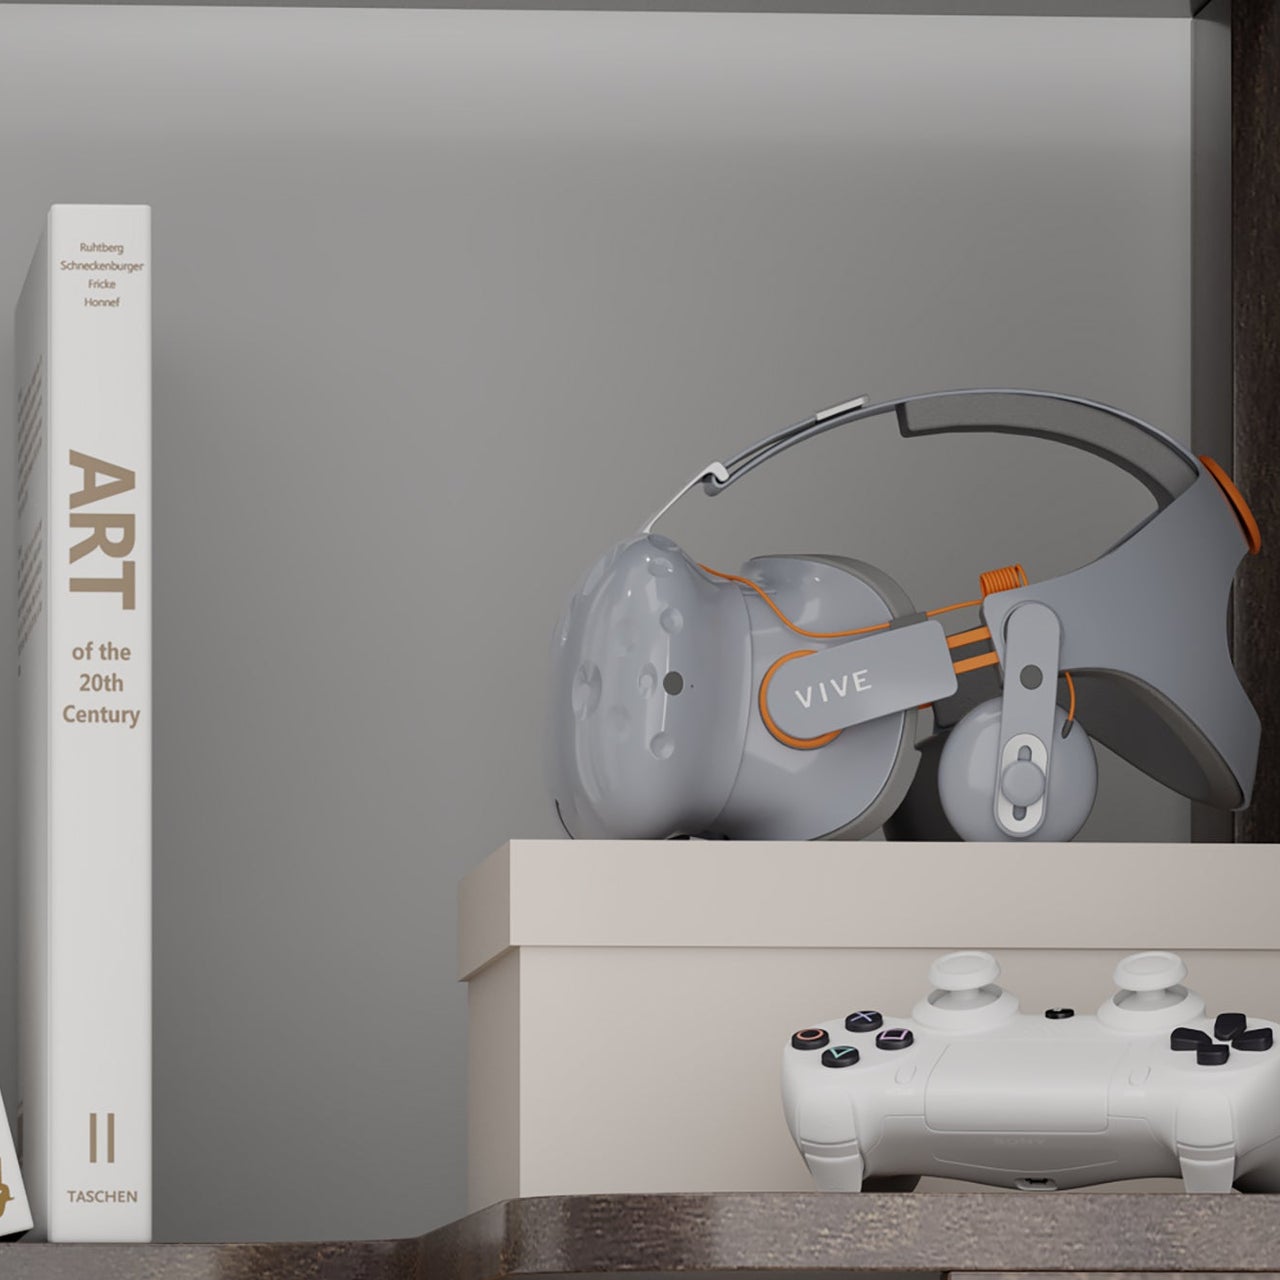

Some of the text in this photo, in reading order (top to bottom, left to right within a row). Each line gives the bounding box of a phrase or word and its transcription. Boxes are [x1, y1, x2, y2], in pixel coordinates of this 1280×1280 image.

[88, 279, 116, 289] Fricke
[84, 297, 120, 307] Honnef
[68, 448, 136, 611] ART
[71, 640, 132, 661] of the
[79, 672, 124, 692] 20th
[794, 669, 873, 709] VIVE
[62, 704, 141, 730] Century
[89, 1112, 115, 1164] II
[66, 1189, 138, 1204] TASCHEN
